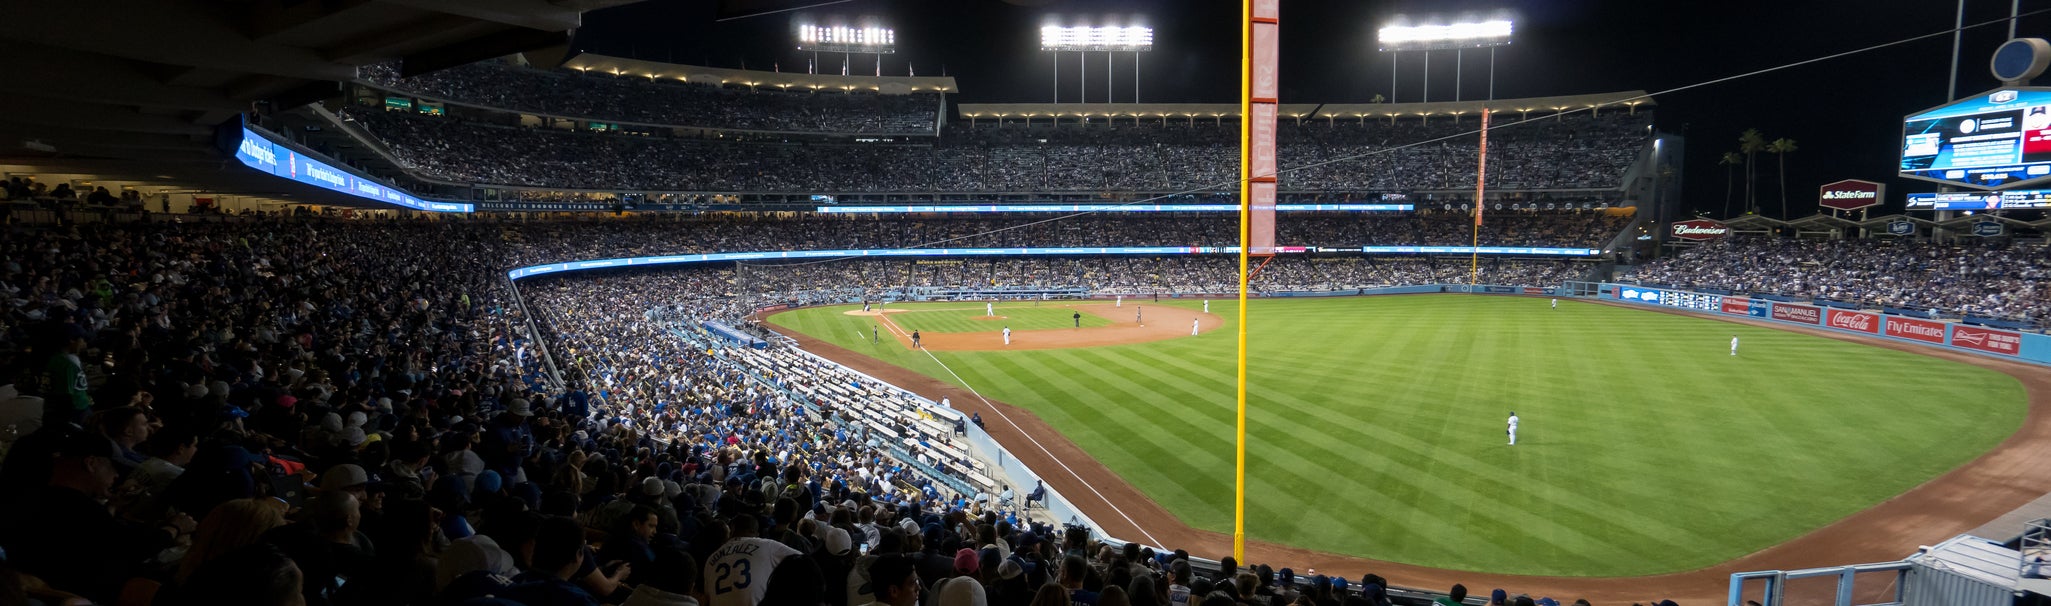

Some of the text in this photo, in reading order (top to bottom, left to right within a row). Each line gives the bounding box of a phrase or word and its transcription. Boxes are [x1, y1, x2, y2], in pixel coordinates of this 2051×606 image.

[1673, 224, 1727, 235] Budweiser
[1774, 305, 1787, 313] SAN
[1791, 307, 1817, 318] MANUEL
[1887, 320, 1943, 337] Fly Emirates
[709, 543, 760, 567] GONZALEZ
[715, 558, 752, 595] 23
